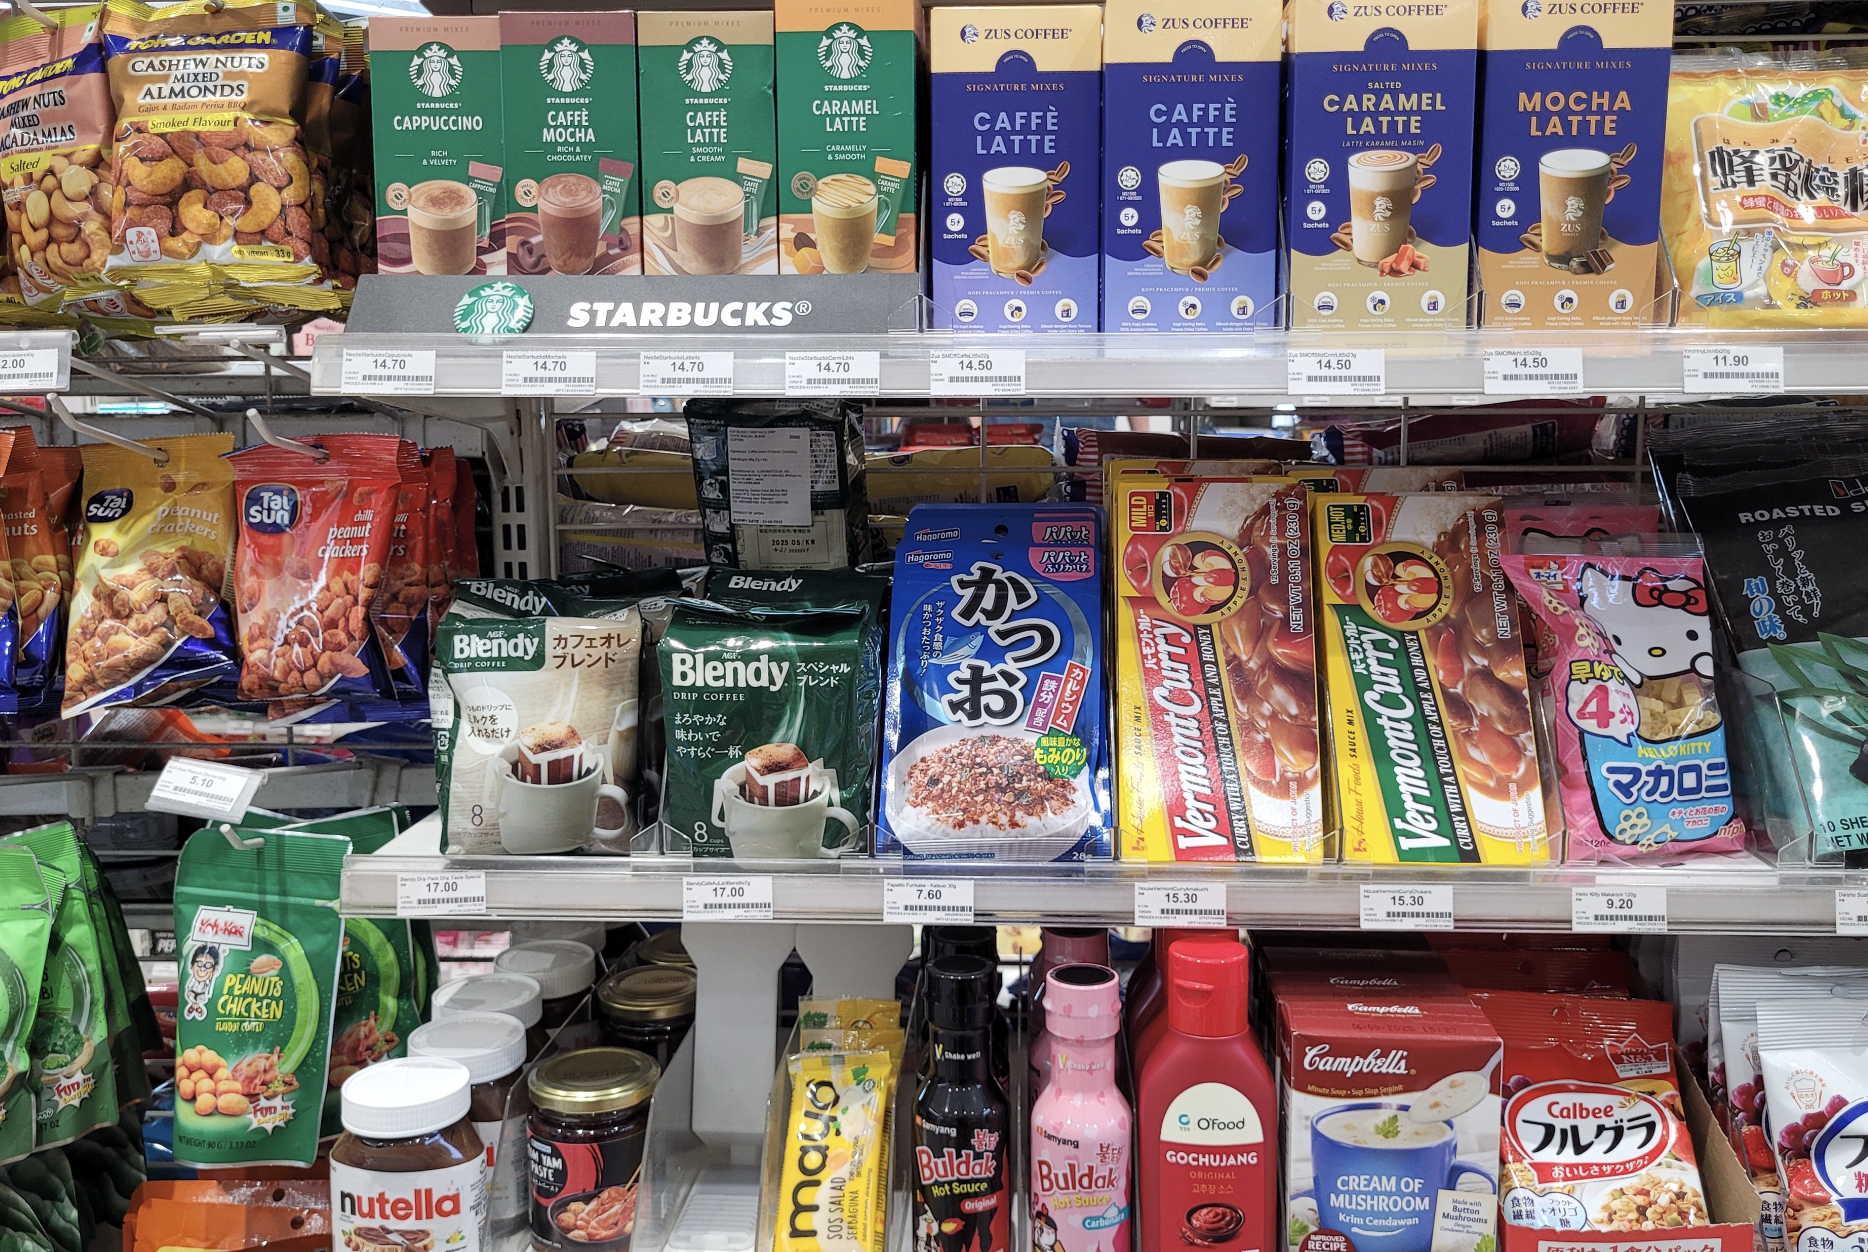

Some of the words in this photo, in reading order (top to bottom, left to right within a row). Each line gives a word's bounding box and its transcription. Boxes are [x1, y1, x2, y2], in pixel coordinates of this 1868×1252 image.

[1354, 6, 1381, 16] ZUS
[1386, 5, 1443, 16] COFFEE
[1548, 4, 1576, 14] ZUS
[1581, 3, 1639, 14] COFFEE
[1162, 18, 1189, 29] ZUS
[1193, 18, 1248, 29] COFFEE
[188, 31, 271, 47] GARDEN
[985, 29, 1011, 39] ZUS
[1015, 28, 1068, 39] COFFEE
[131, 56, 211, 73] CASHEW
[212, 56, 267, 70] NUTS
[172, 72, 219, 84] MIXED
[141, 84, 245, 100] ALMONDS
[813, 100, 879, 115] CARAMEL
[1323, 93, 1445, 112] CARAMEL
[1518, 91, 1631, 112] MOCHA
[548, 108, 588, 126] CAFFÈ
[686, 109, 727, 126] CAFFÈ
[1150, 97, 1236, 123] CAFFÈ
[9, 113, 40, 131] MIXED
[394, 116, 483, 131] CAPPUCCINO
[826, 117, 866, 131] LATTE
[974, 106, 1058, 131] CAFFÈ
[1347, 116, 1421, 134] LATTE
[1530, 116, 1617, 136] LATTE
[543, 128, 595, 142] MOCHA
[688, 128, 727, 143] LATTE
[1152, 128, 1234, 147] LATTE
[977, 135, 1056, 154] LATTE
[1561, 224, 1580, 232] ZUS
[1704, 293, 1736, 305] アイス
[1821, 291, 1849, 301] ホット
[372, 359, 406, 371] 14.70
[533, 361, 567, 371] 14.70
[671, 361, 704, 372] 14.70
[816, 362, 850, 373] 14.70
[958, 360, 992, 371] 14.50
[1317, 359, 1351, 370] 14.50
[1512, 358, 1548, 368] 14.50
[1713, 356, 1748, 366] 11.90
[103, 492, 127, 509] Tai
[260, 490, 290, 509] Tai
[1286, 498, 1299, 510] g)
[88, 504, 123, 518] Sun
[158, 505, 220, 524] peanut
[250, 507, 290, 523] Sun
[1131, 496, 1147, 527] MILD
[1738, 505, 1840, 523] ROASTED
[148, 520, 217, 540] crackers
[1286, 513, 1299, 538] (230
[1330, 506, 1346, 542] MED.HOT
[328, 524, 370, 544] peanut
[318, 544, 369, 558] crackers
[1287, 540, 1299, 557] OZ
[908, 552, 952, 563] Hagoromo
[1043, 565, 1088, 573] ふりかけ
[1288, 559, 1301, 584] 8.11
[729, 576, 803, 592] Blendy
[470, 581, 547, 615] Blendy
[1290, 587, 1301, 604] WT
[1290, 605, 1303, 632] NET
[454, 633, 539, 660] Blendy
[553, 633, 631, 649] カフェオレ
[945, 562, 1057, 724] かつお
[553, 652, 617, 669] ブレンド
[797, 662, 850, 673] スペシャル
[672, 653, 789, 692] Blendy
[1571, 662, 1624, 684] 早ゆで
[673, 692, 698, 700] DRIP
[704, 693, 745, 701] COFFEE
[1056, 667, 1085, 728] カルシウム
[675, 713, 727, 726] まろやかな
[1346, 709, 1354, 726] MIX
[676, 729, 721, 741] 味わいで
[1041, 738, 1080, 747] 風味豊かな
[1349, 730, 1357, 758] SAUCE
[1638, 744, 1677, 758] HELLO
[1679, 741, 1710, 754] KITTY
[676, 746, 742, 759] やすらぐ一杯
[1034, 748, 1086, 765] もみのり
[1055, 766, 1068, 775] 入り
[190, 776, 213, 787] 5.10
[1604, 761, 1730, 802] マカロニ
[426, 882, 458, 893] 17.00
[713, 887, 744, 897] 17.00
[916, 889, 942, 900] 7.60
[1165, 893, 1197, 904] 15.30
[1390, 895, 1424, 907] 15.30
[1606, 899, 1633, 909] 9.20
[224, 974, 283, 997] PEANUTS
[217, 997, 283, 1020] CHICKEN
[1303, 1044, 1408, 1078] Campbell's
[1307, 1084, 1329, 1094] Minute
[1331, 1088, 1346, 1096] Soup
[1352, 1088, 1363, 1096] Sup
[1364, 1087, 1378, 1095] Siap
[1379, 1084, 1403, 1092] Seminit
[1547, 1102, 1614, 1119] Calbee
[1198, 1118, 1245, 1130] O'Food
[972, 1129, 999, 1150] 불닭
[1522, 1114, 1656, 1155] フルグラ
[789, 1079, 840, 1238] mayo
[1096, 1143, 1121, 1163] 불닭
[1166, 1151, 1257, 1166] GOCHUJANG
[541, 1156, 562, 1169] YAM
[916, 1147, 997, 1185] Buldak
[531, 1164, 554, 1181] PASTE
[1037, 1159, 1118, 1195] Buldak
[1190, 1171, 1236, 1179] ORIGINAL
[932, 1185, 951, 1197] Hot
[952, 1182, 988, 1193] Sauce
[1192, 1184, 1216, 1193] 고추장
[1218, 1184, 1233, 1193] 소스
[1337, 1175, 1396, 1193] CREAM
[1400, 1179, 1424, 1193] OF
[340, 1188, 461, 1223] nutella
[965, 1197, 997, 1209] Original
[1052, 1198, 1072, 1209] Hot
[1074, 1195, 1110, 1206] Sauce
[1330, 1194, 1429, 1211] MUSHROOM
[1453, 1205, 1479, 1215] Button
[1085, 1213, 1125, 1227] Carbonara
[1339, 1213, 1363, 1225] Krim
[1366, 1215, 1418, 1226] Cendawan
[1442, 1212, 1488, 1224] Mushrooms
[1308, 1241, 1347, 1251] RECIPE
